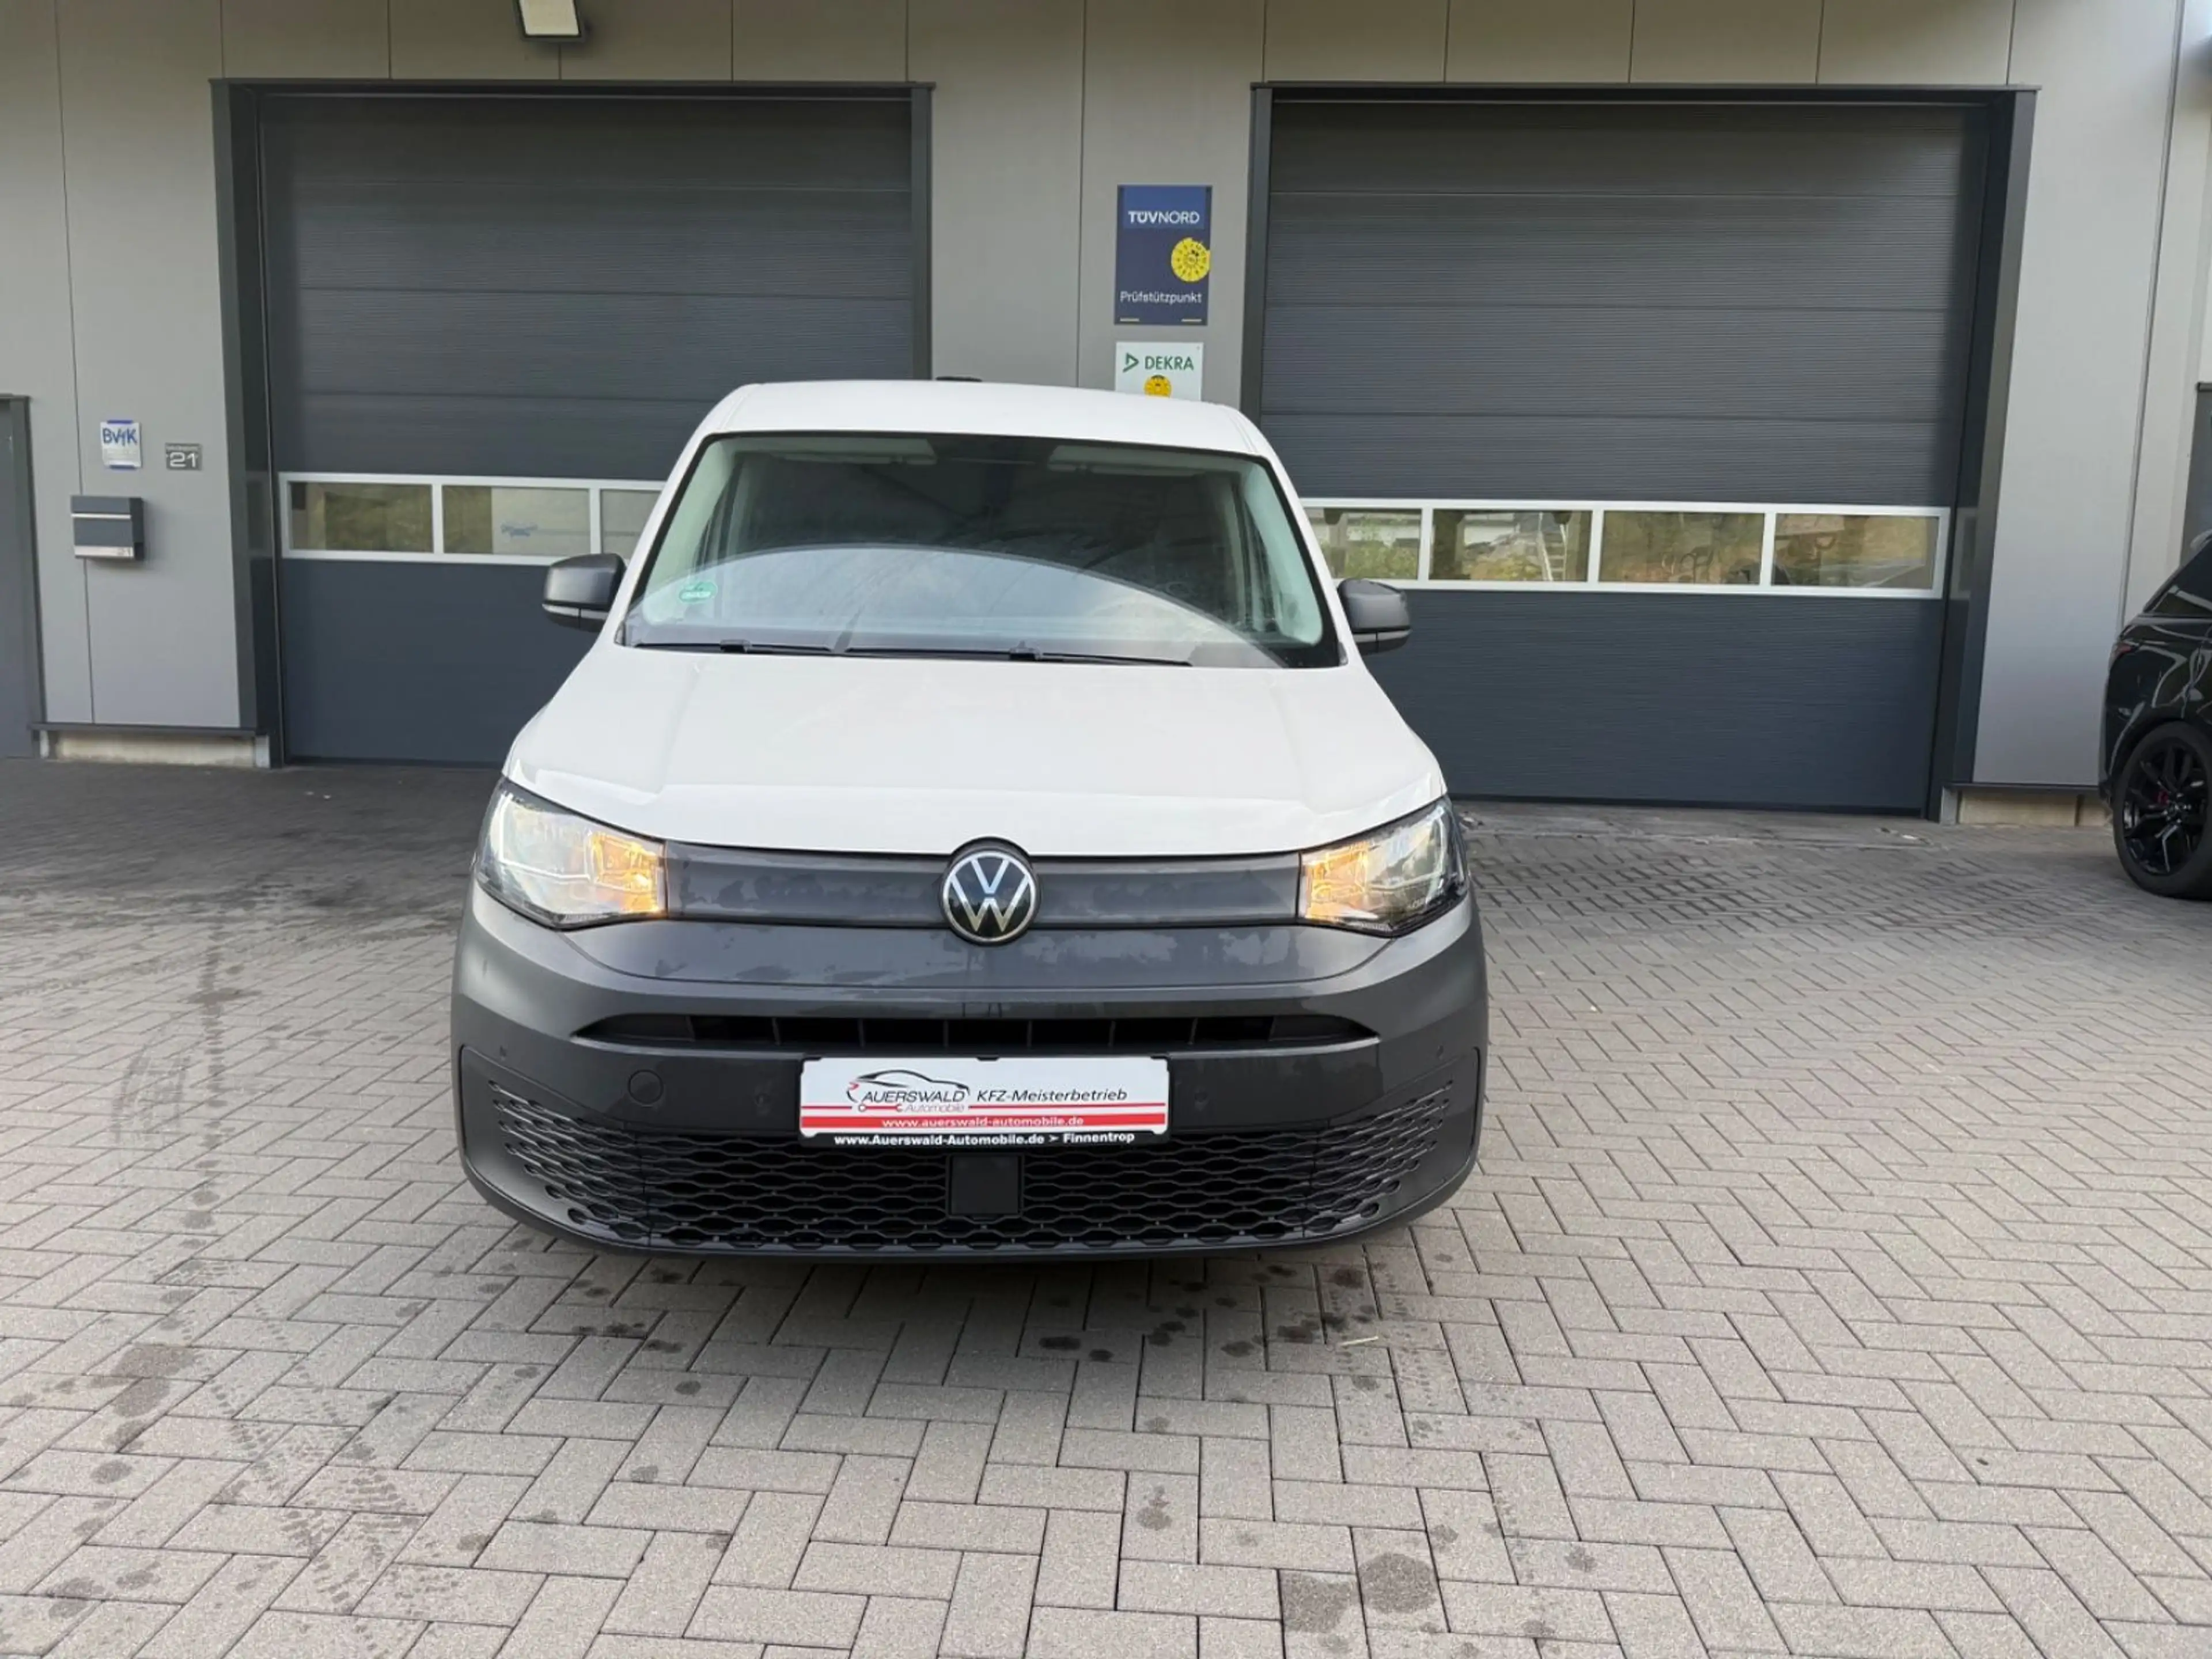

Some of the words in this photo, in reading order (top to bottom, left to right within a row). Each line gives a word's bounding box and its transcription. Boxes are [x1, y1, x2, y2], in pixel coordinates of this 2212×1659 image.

[1120, 291, 1202, 305] Prüfstützpunkt
[1145, 355, 1194, 371] DEKRA
[170, 452, 196, 467] 21
[862, 1090, 965, 1103] AUERSWALD
[977, 1089, 1127, 1102] KFZ-Meisterbetrieb
[882, 1117, 1084, 1127] www.auerswald-automobile.de
[834, 1134, 1044, 1145] www.Auerswald-Automobile.de
[1063, 1132, 1135, 1143] Finnentrop
